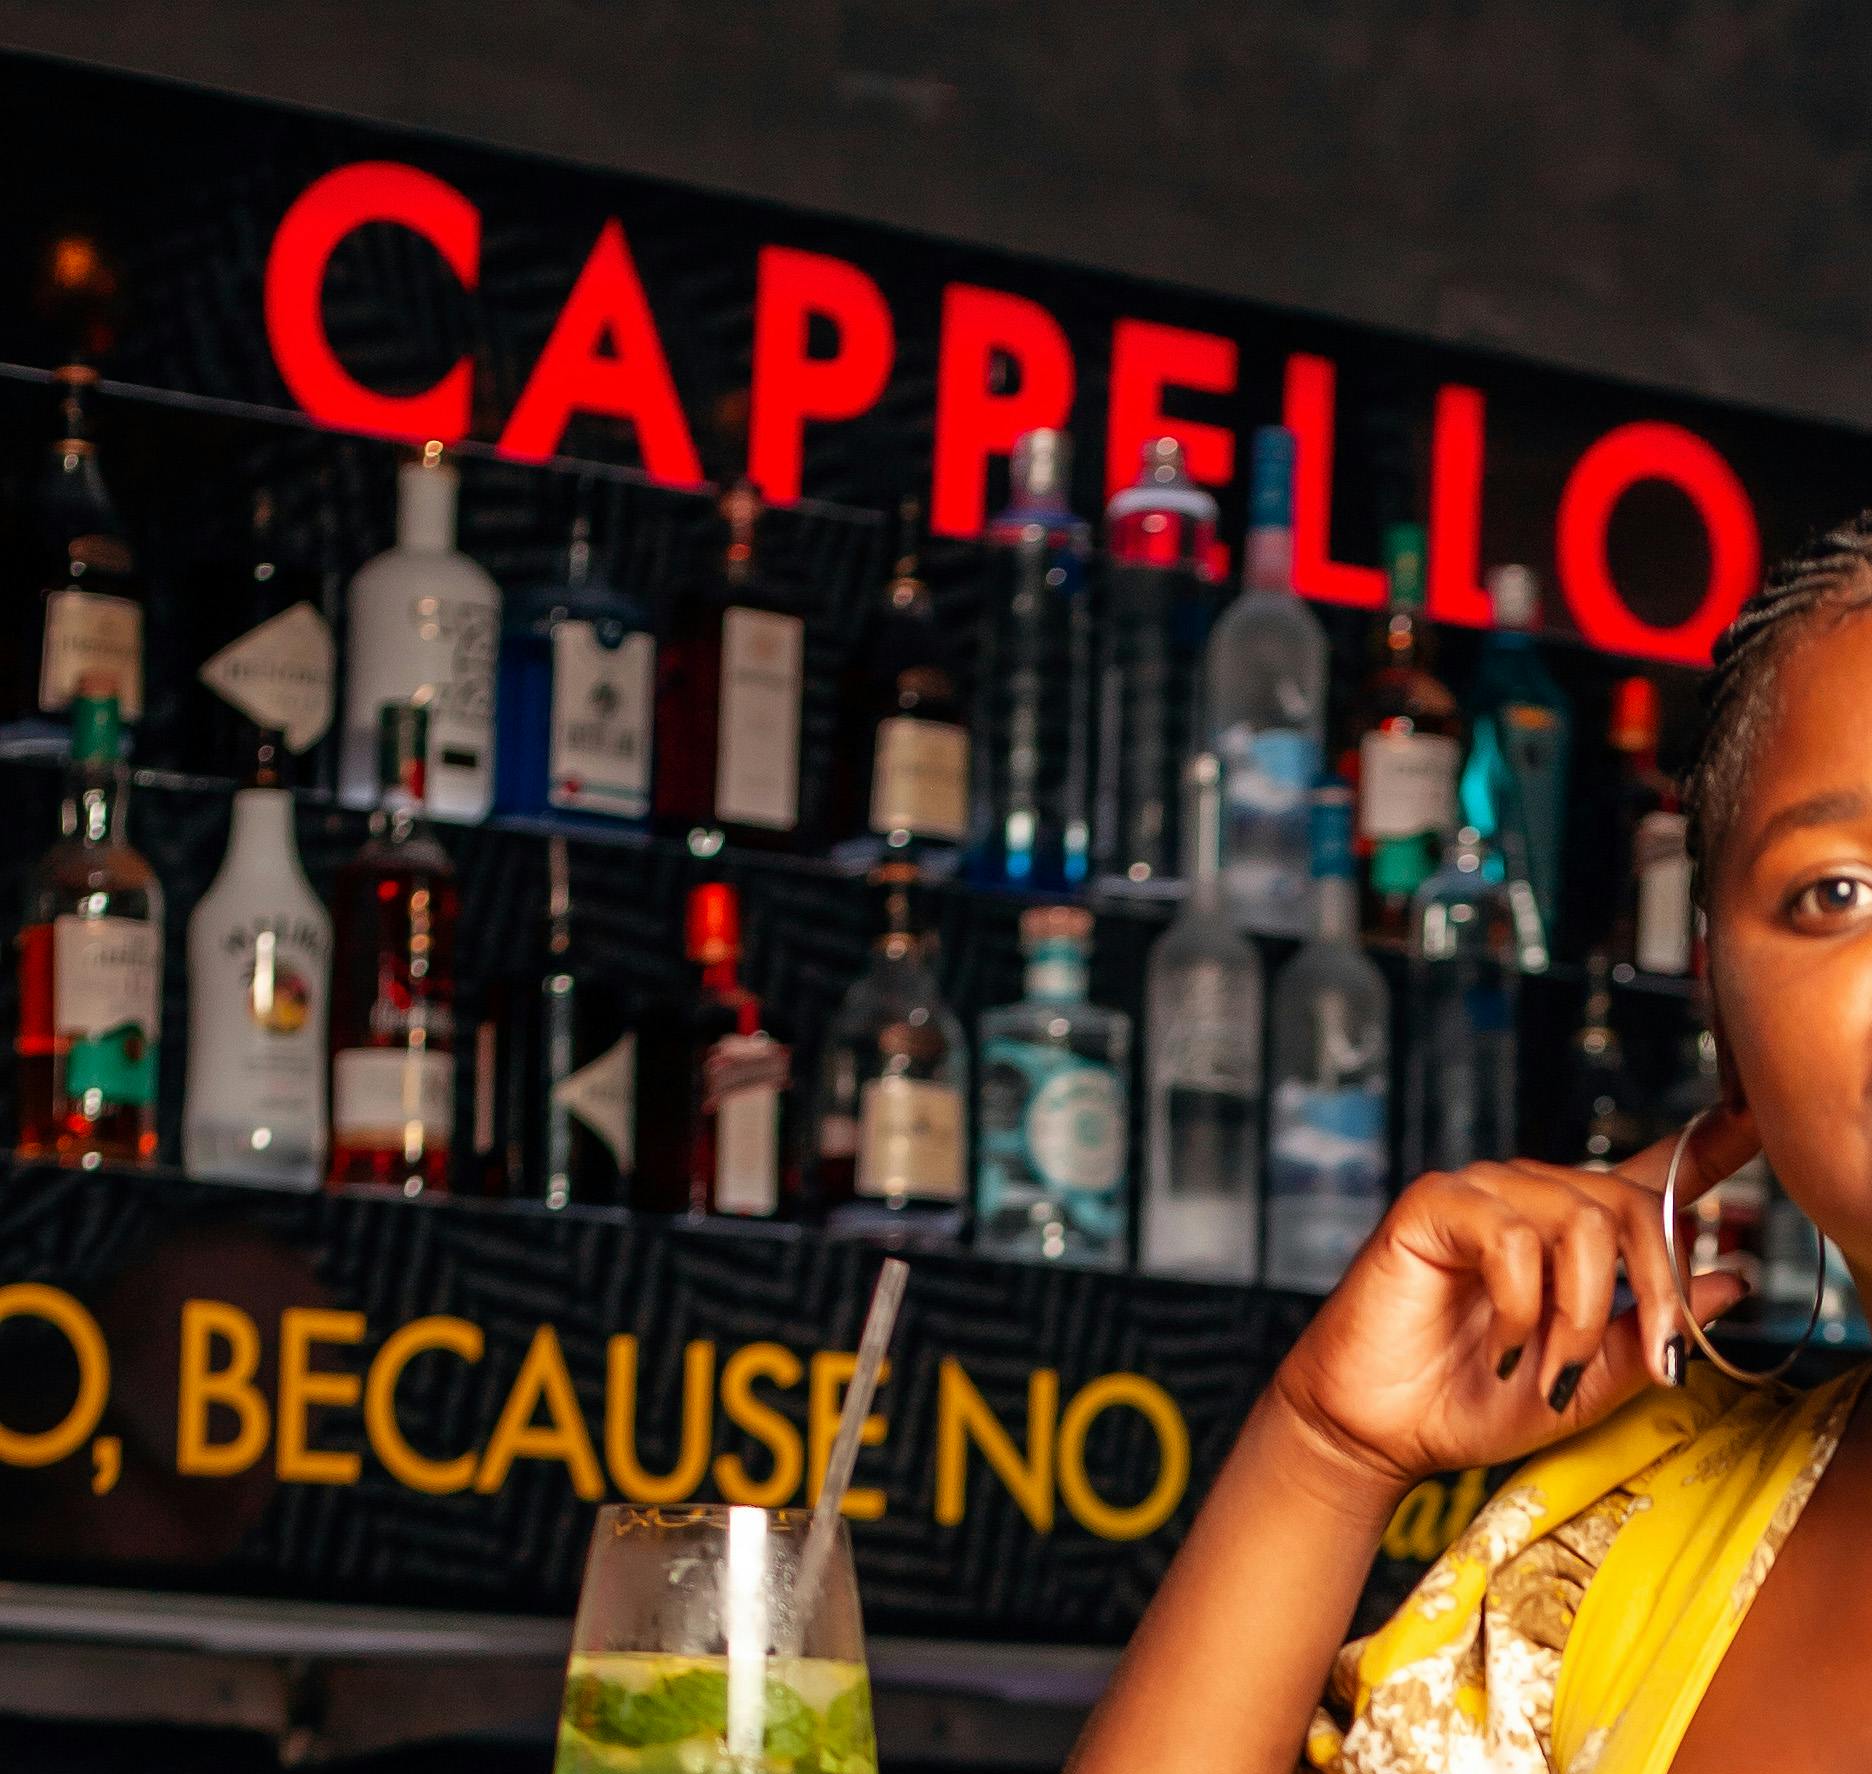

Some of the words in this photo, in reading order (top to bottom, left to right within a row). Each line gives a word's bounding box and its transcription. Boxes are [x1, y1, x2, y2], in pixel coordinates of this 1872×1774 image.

[264, 160, 1760, 668] CAPPELLO
[176, 1298, 890, 1520] BECAUSE
[935, 1355, 1190, 1541] NO
